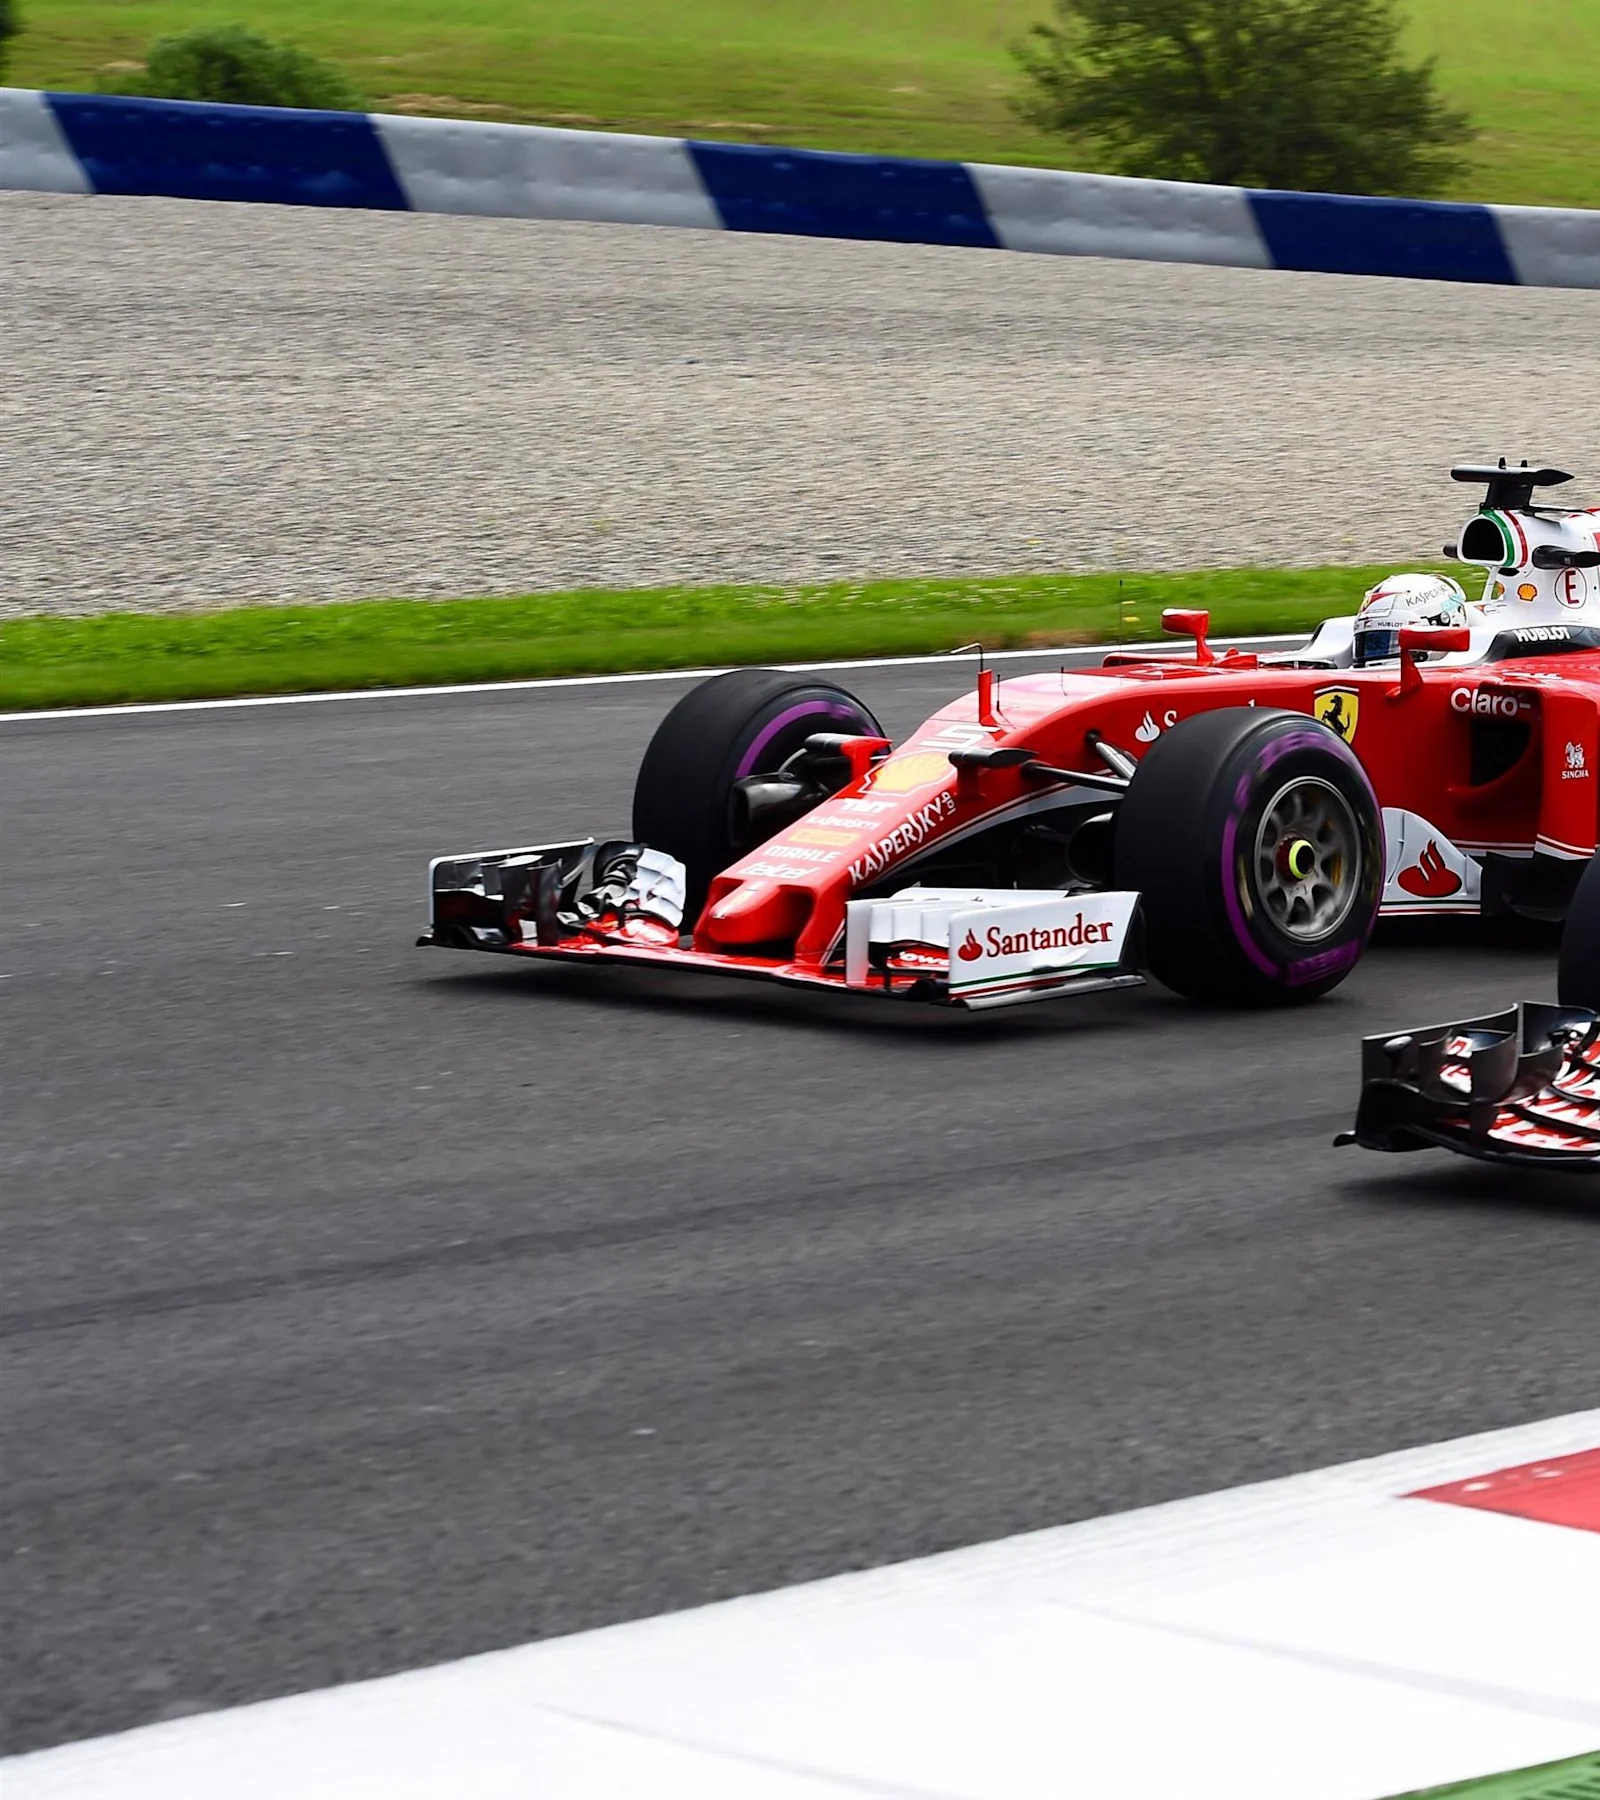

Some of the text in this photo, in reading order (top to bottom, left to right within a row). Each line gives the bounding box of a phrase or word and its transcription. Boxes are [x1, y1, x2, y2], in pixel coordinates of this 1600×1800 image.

[1564, 570, 1580, 605] E
[1513, 626, 1571, 643] HUBLOT
[1561, 769, 1590, 780] SINGHA
[763, 844, 843, 863] MAHLE
[847, 796, 949, 885] KASPERSKY
[986, 912, 1113, 958] Santander
